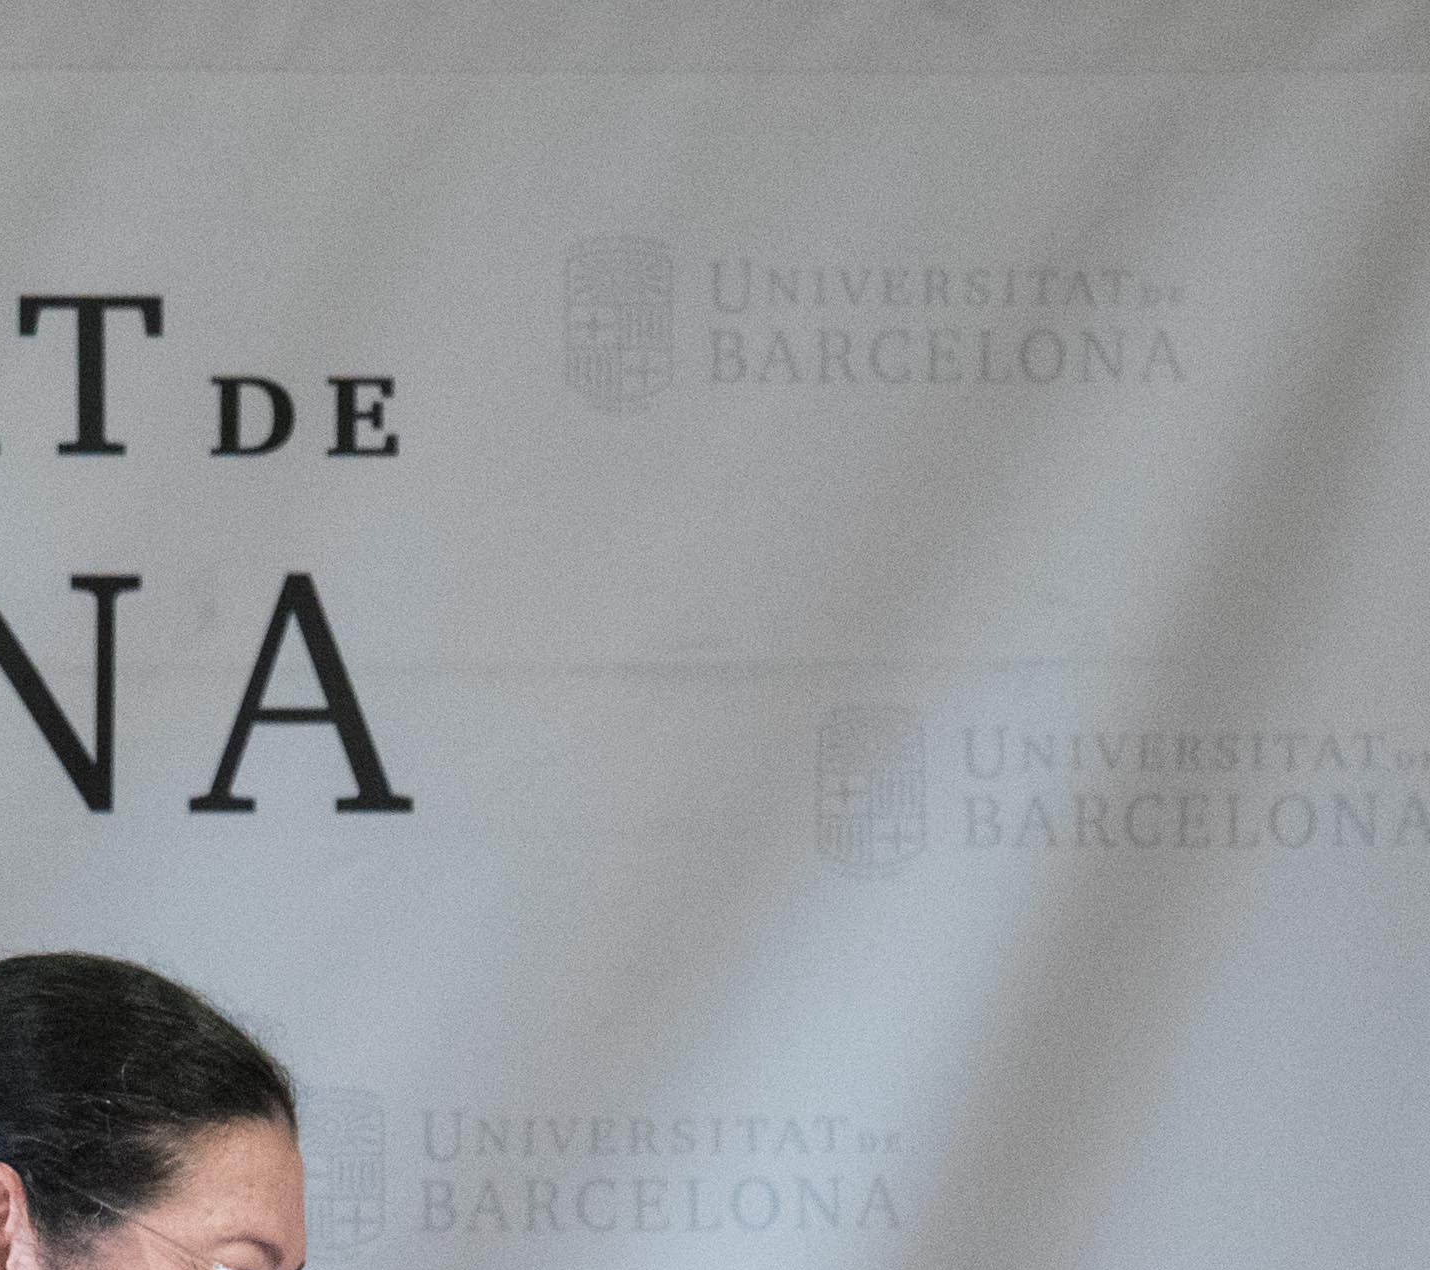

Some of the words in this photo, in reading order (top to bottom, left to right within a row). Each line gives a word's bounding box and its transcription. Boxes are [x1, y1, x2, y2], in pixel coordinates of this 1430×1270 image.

[708, 259, 1134, 313] UNIVERSITAT
[706, 326, 1188, 386] BARCELONA
[211, 375, 400, 457] DE
[961, 725, 1386, 780] UNIVERSITAT
[420, 1109, 849, 1163] UNIVERSITAT
[418, 1174, 902, 1233] BARCELONA
